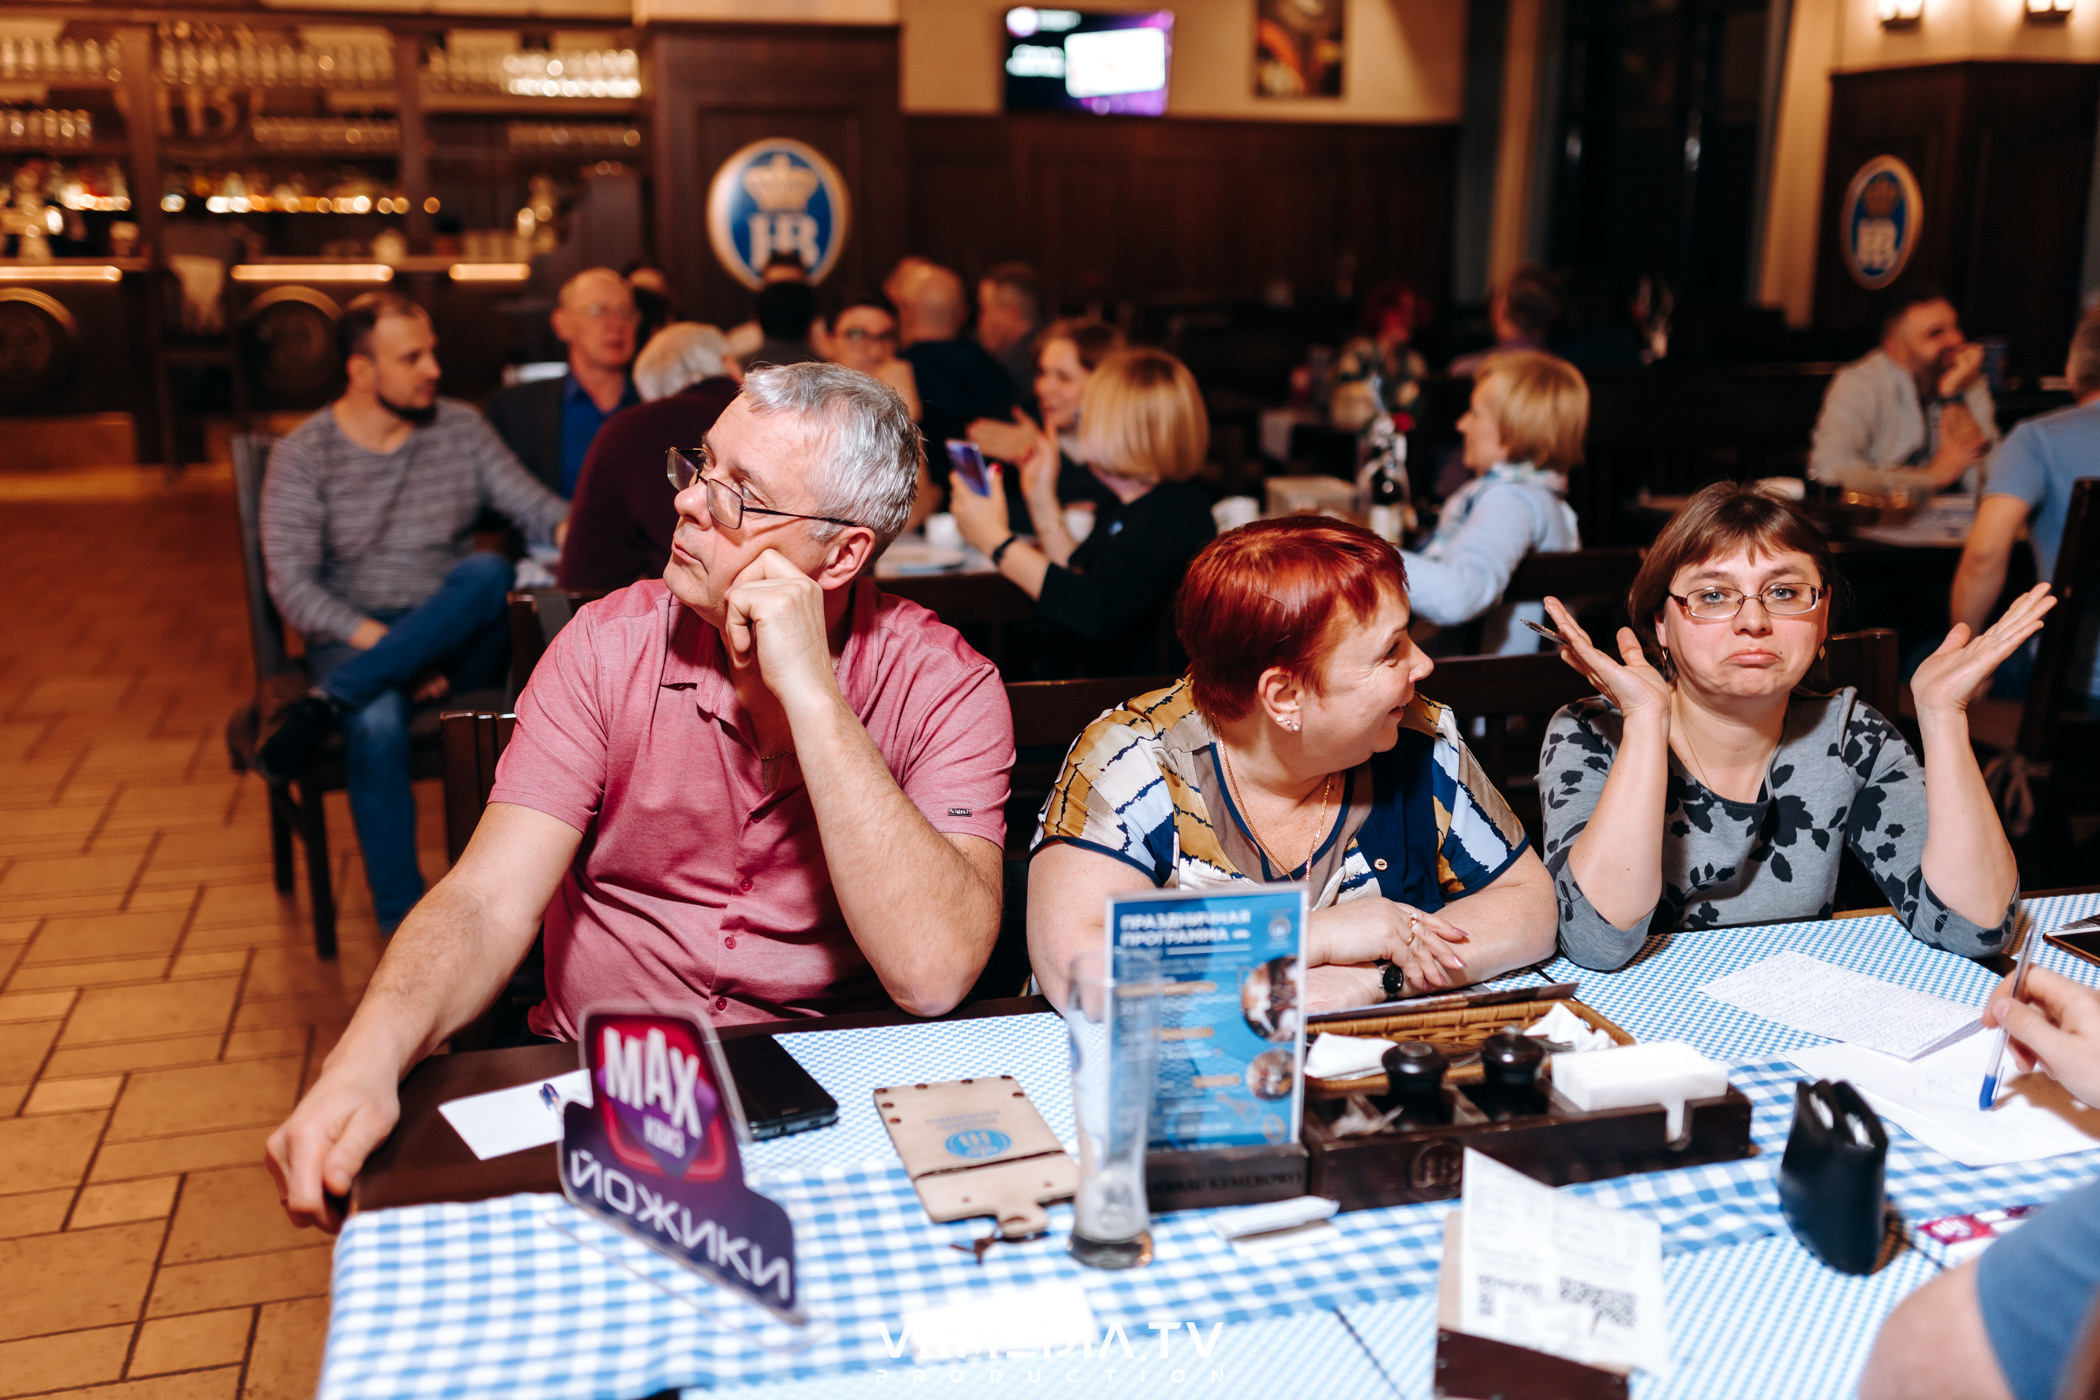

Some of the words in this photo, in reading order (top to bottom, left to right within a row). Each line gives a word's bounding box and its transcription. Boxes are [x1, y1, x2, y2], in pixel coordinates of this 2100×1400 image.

[1120, 927, 1230, 947] ПРОГРАММА
[604, 1027, 703, 1140] MAX
[571, 1150, 790, 1300] ЙОЖИКИ
